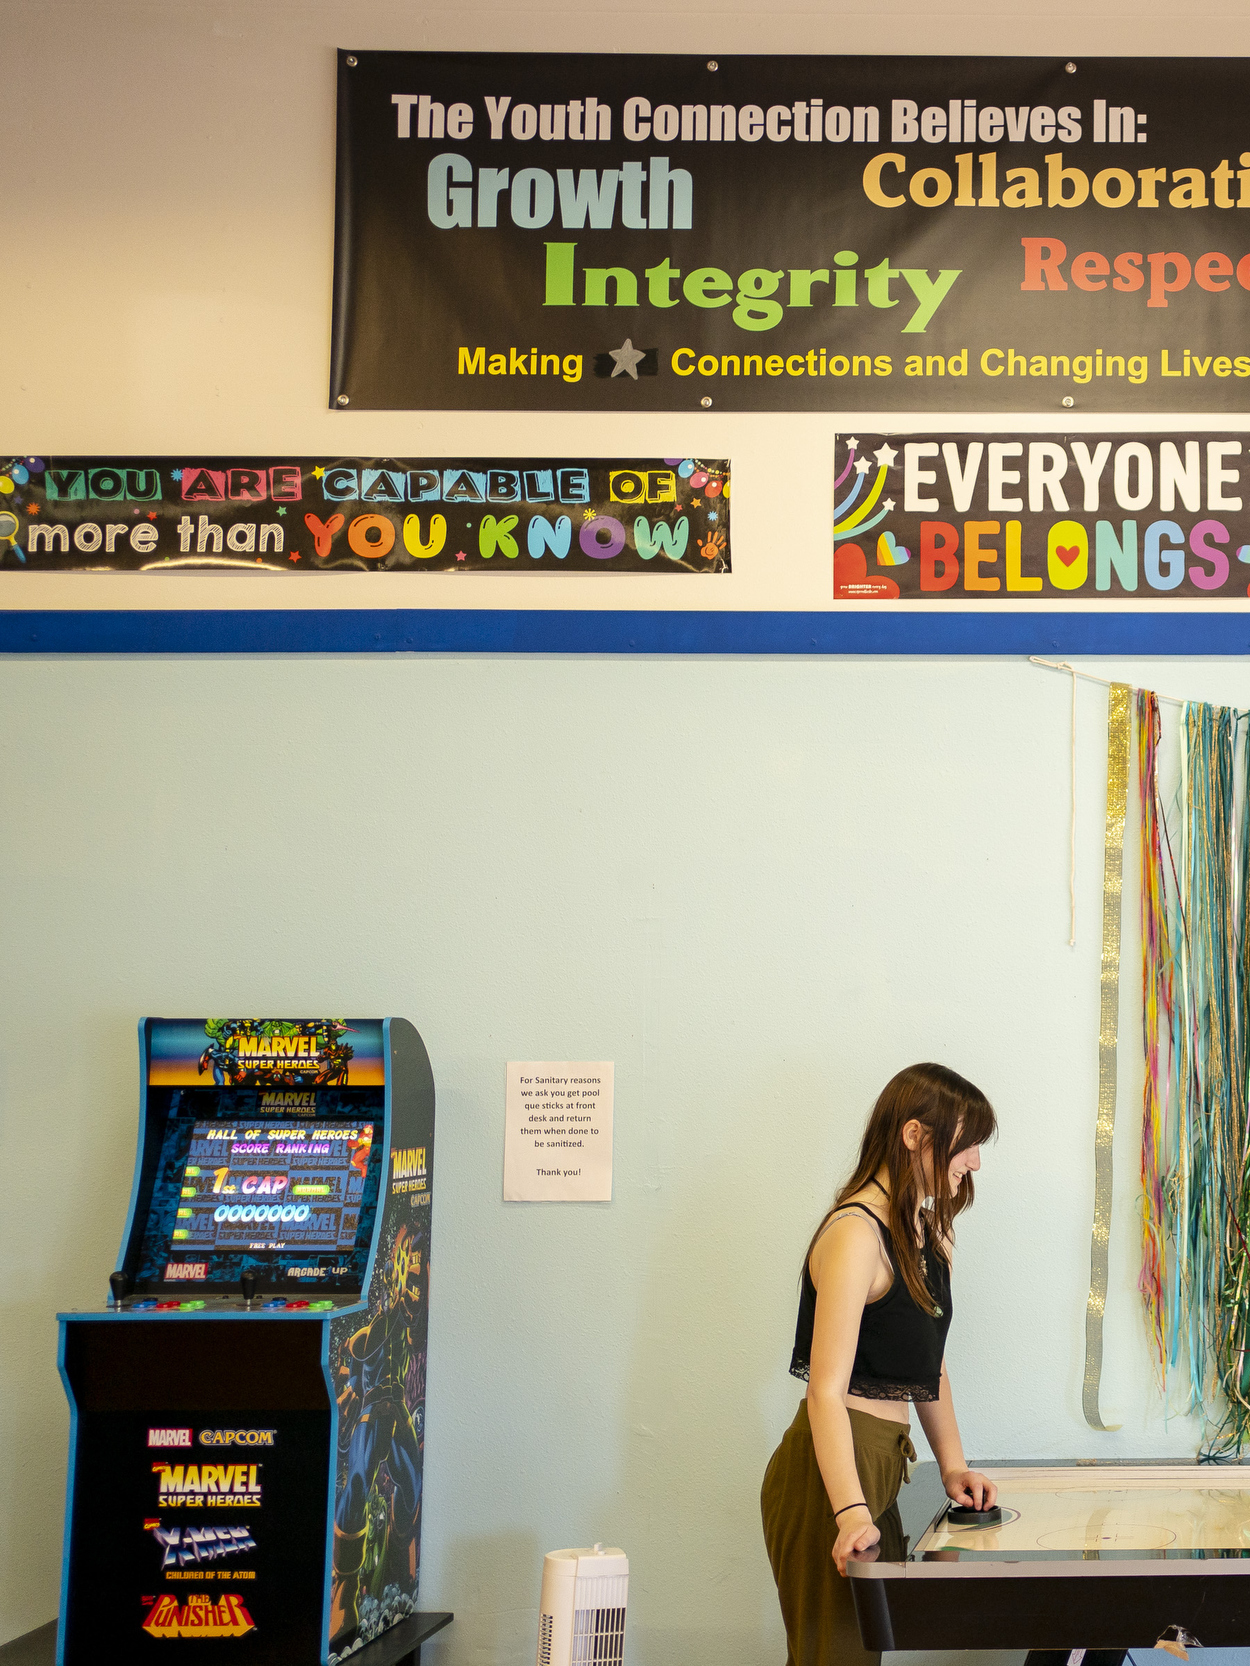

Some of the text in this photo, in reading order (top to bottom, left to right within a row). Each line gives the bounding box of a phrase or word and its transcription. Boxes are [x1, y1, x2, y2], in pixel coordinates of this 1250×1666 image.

[391, 94, 1147, 143] The Youth Connection Believes In:
[426, 153, 693, 229] Growth
[542, 241, 962, 333] Integrity
[457, 346, 583, 382] Making
[670, 347, 893, 377] Connections
[904, 347, 969, 377] and
[979, 348, 1148, 384] Changing
[904, 441, 1243, 512] EVERYONE
[45, 466, 677, 504] YOU ARE CAPABLE OF
[28, 512, 690, 560] more than YOU KNOW
[919, 519, 1230, 592] BELONGS
[238, 1035, 320, 1057] MARVEL
[237, 1060, 320, 1069] SUPER HEROES
[520, 1076, 533, 1084] For
[535, 1076, 568, 1085] Sanitary
[261, 1092, 316, 1106] MARVEL
[535, 1089, 548, 1097] ask
[550, 1090, 565, 1098] you
[567, 1089, 580, 1098] get
[582, 1089, 600, 1098] pool
[528, 1114, 547, 1122] desk
[549, 1114, 564, 1122] and
[206, 1129, 358, 1141] HALL OF SUPER HEROES
[520, 1127, 541, 1135] them
[544, 1127, 566, 1135] when
[568, 1127, 588, 1135] done
[190, 1140, 228, 1156] ARVEL
[231, 1143, 330, 1154] SCORE RANKING
[534, 1140, 585, 1148] be sanitized.
[392, 1146, 427, 1180] MARVEL
[536, 1168, 581, 1177] Thank you!
[241, 1175, 288, 1195] CAP
[392, 1178, 426, 1194] SUPER HEROES
[410, 1192, 430, 1208] CAPCOM
[214, 1204, 311, 1222] 0000000
[165, 1264, 207, 1279] MARVEL
[287, 1267, 326, 1277] ARCADE
[148, 1429, 274, 1446] MARVEL CAPCOM
[160, 1464, 262, 1493] MARVEL
[158, 1495, 261, 1507] SUPER HEROES
[153, 1526, 257, 1571] X-MEN
[165, 1571, 256, 1580] CHILDREN OF THE ATOM
[189, 1594, 211, 1604] THE
[142, 1594, 255, 1629] PUNISHER
